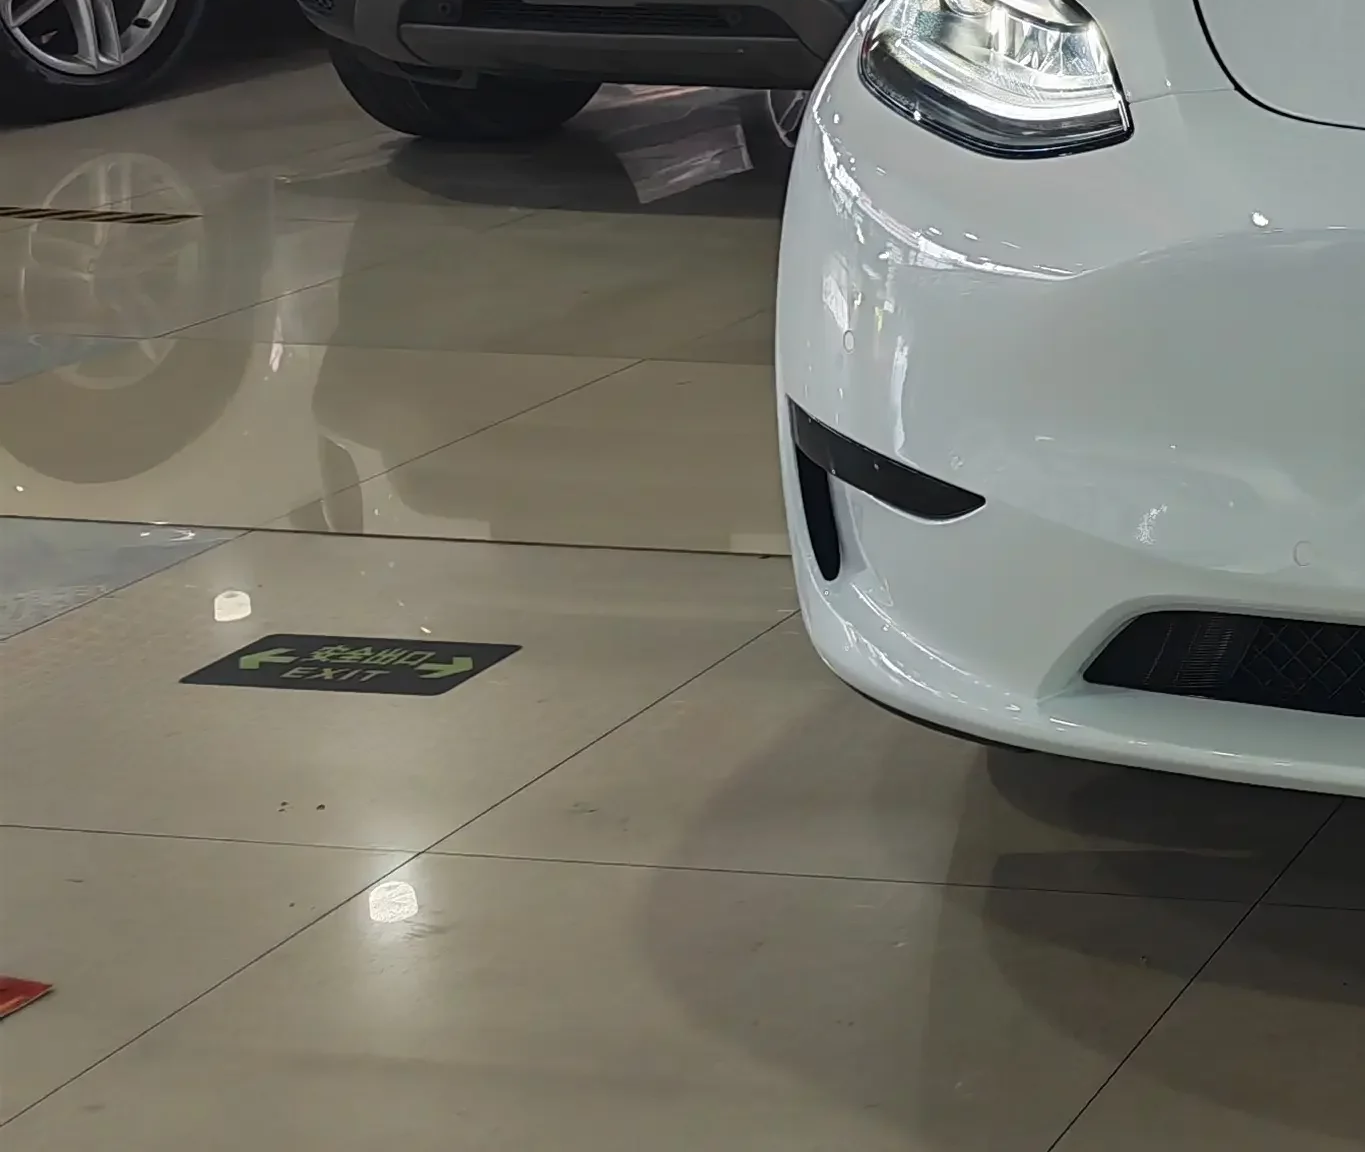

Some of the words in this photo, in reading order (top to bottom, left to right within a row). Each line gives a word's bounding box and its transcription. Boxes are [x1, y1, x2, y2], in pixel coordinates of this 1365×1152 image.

[303, 645, 436, 666] 安全出口
[280, 666, 391, 682] EXIT
